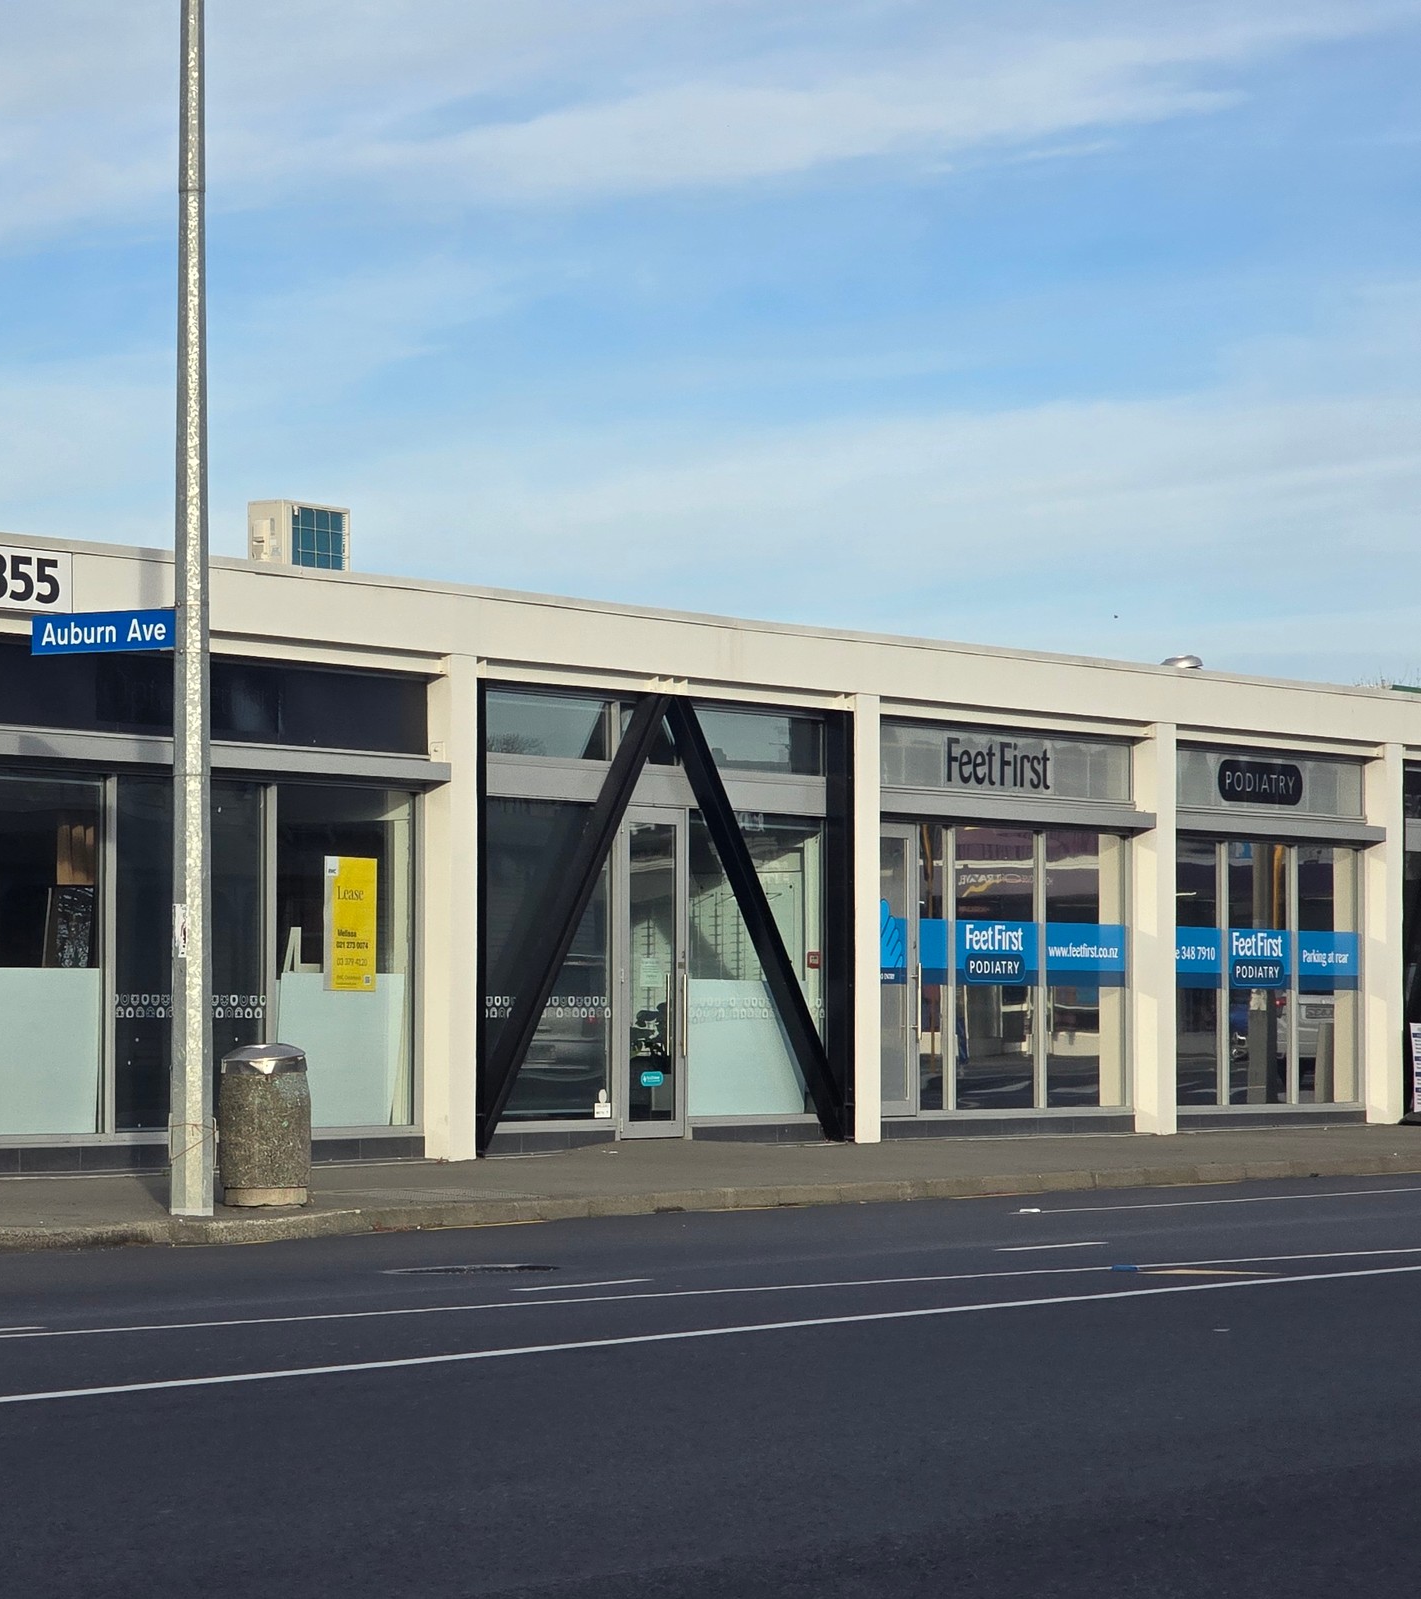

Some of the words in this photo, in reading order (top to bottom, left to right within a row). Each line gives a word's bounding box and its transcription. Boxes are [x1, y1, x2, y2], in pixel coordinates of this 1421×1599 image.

[41, 621, 117, 646] Auburn
[127, 618, 167, 642] Ave
[1225, 770, 1296, 795] PODIATRY
[337, 886, 364, 901] Lease
[1048, 942, 1119, 959] www.feetfirst.co.nz
[1181, 945, 1196, 960] 348
[1197, 946, 1216, 961] 7910
[1302, 949, 1327, 968] Parking
[1327, 951, 1335, 964] at
[1335, 953, 1349, 964] rear
[969, 960, 1020, 974] PODIATRY
[1236, 965, 1280, 979] PODIATRY
